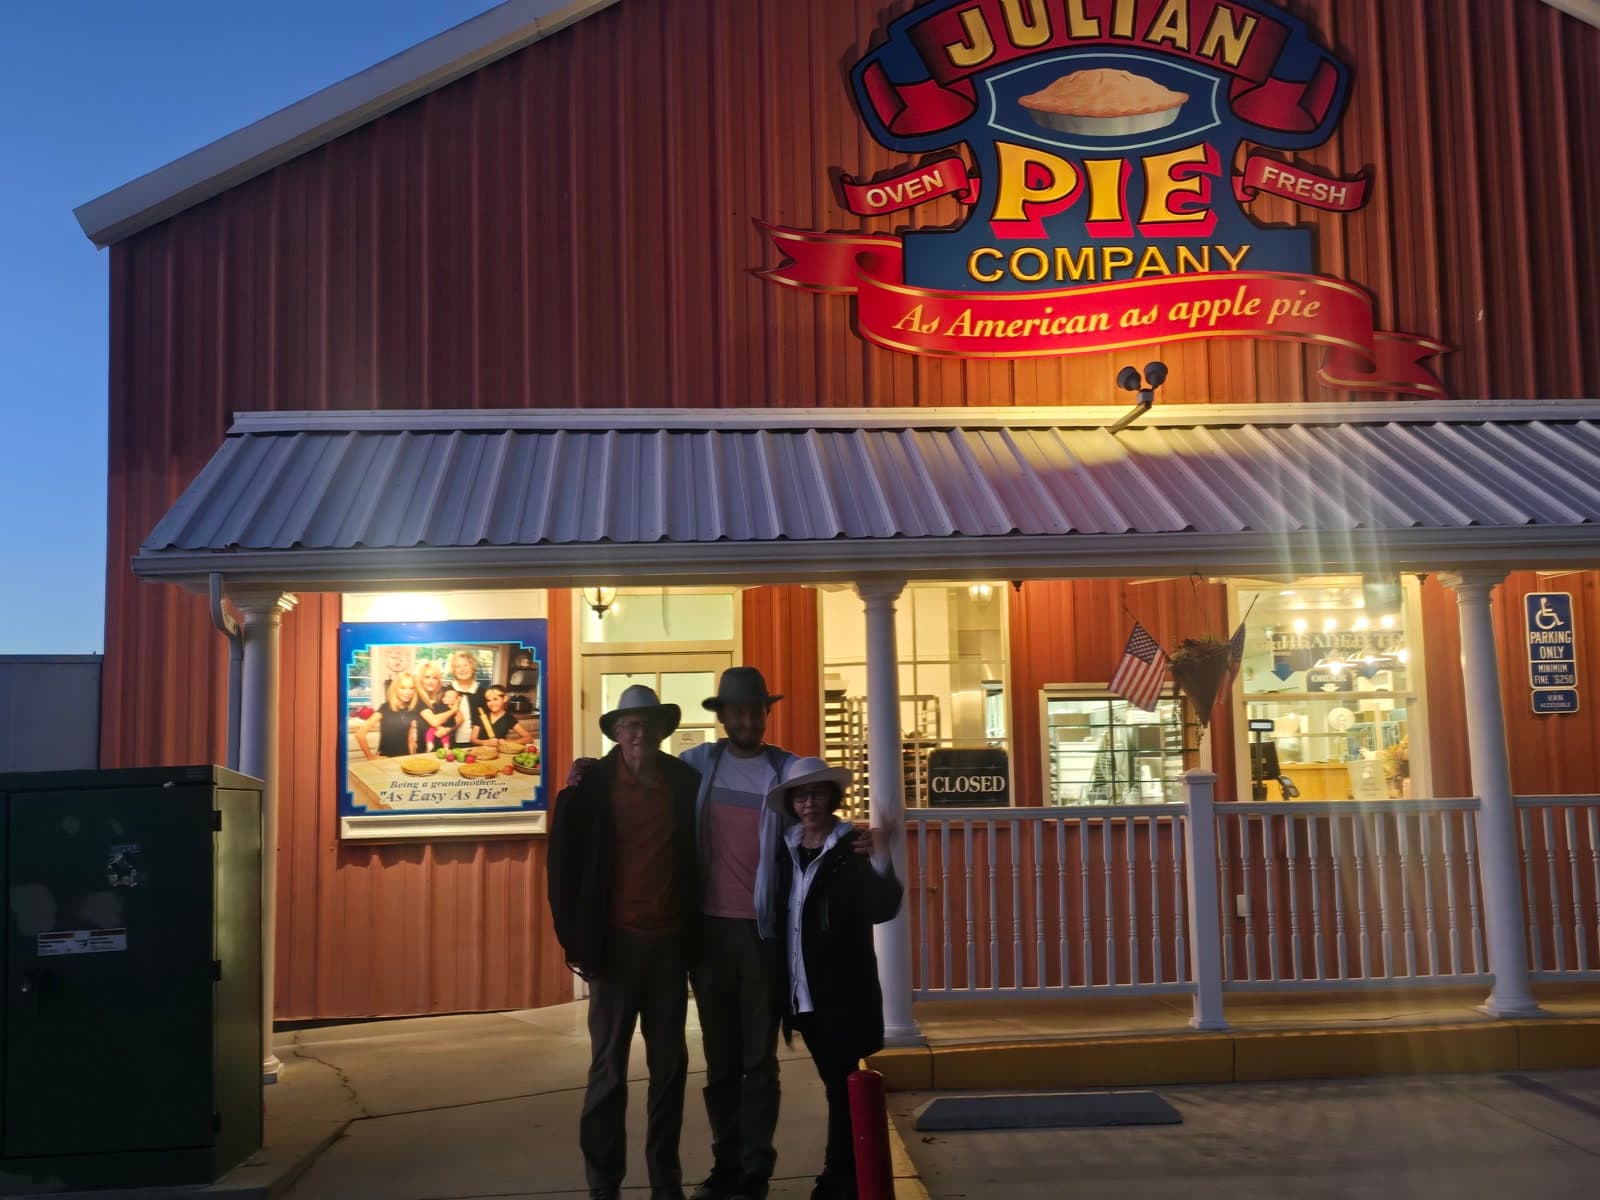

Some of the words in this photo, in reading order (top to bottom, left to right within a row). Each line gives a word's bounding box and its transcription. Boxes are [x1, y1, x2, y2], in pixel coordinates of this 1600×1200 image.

[945, 0, 1258, 69] JULIAN
[865, 169, 944, 209] OVEN
[988, 141, 1218, 238] PIE
[1261, 165, 1348, 206] FRESH
[967, 244, 1251, 283] COMPANY
[893, 303, 940, 336] As
[943, 306, 1109, 338] American
[1119, 304, 1159, 327] as
[1168, 284, 1261, 329] apple
[1265, 289, 1321, 325] pie
[1530, 630, 1572, 644] PARKING
[1539, 646, 1564, 659] ONLY
[1538, 664, 1568, 673] MINIMUM
[1534, 675, 1549, 684] FINE
[390, 779, 418, 789] Being
[932, 777, 1005, 792] CLOSED
[380, 789, 402, 803] "As
[408, 789, 446, 804] Easy
[450, 788, 472, 801] As
[476, 787, 508, 801] Pie"
